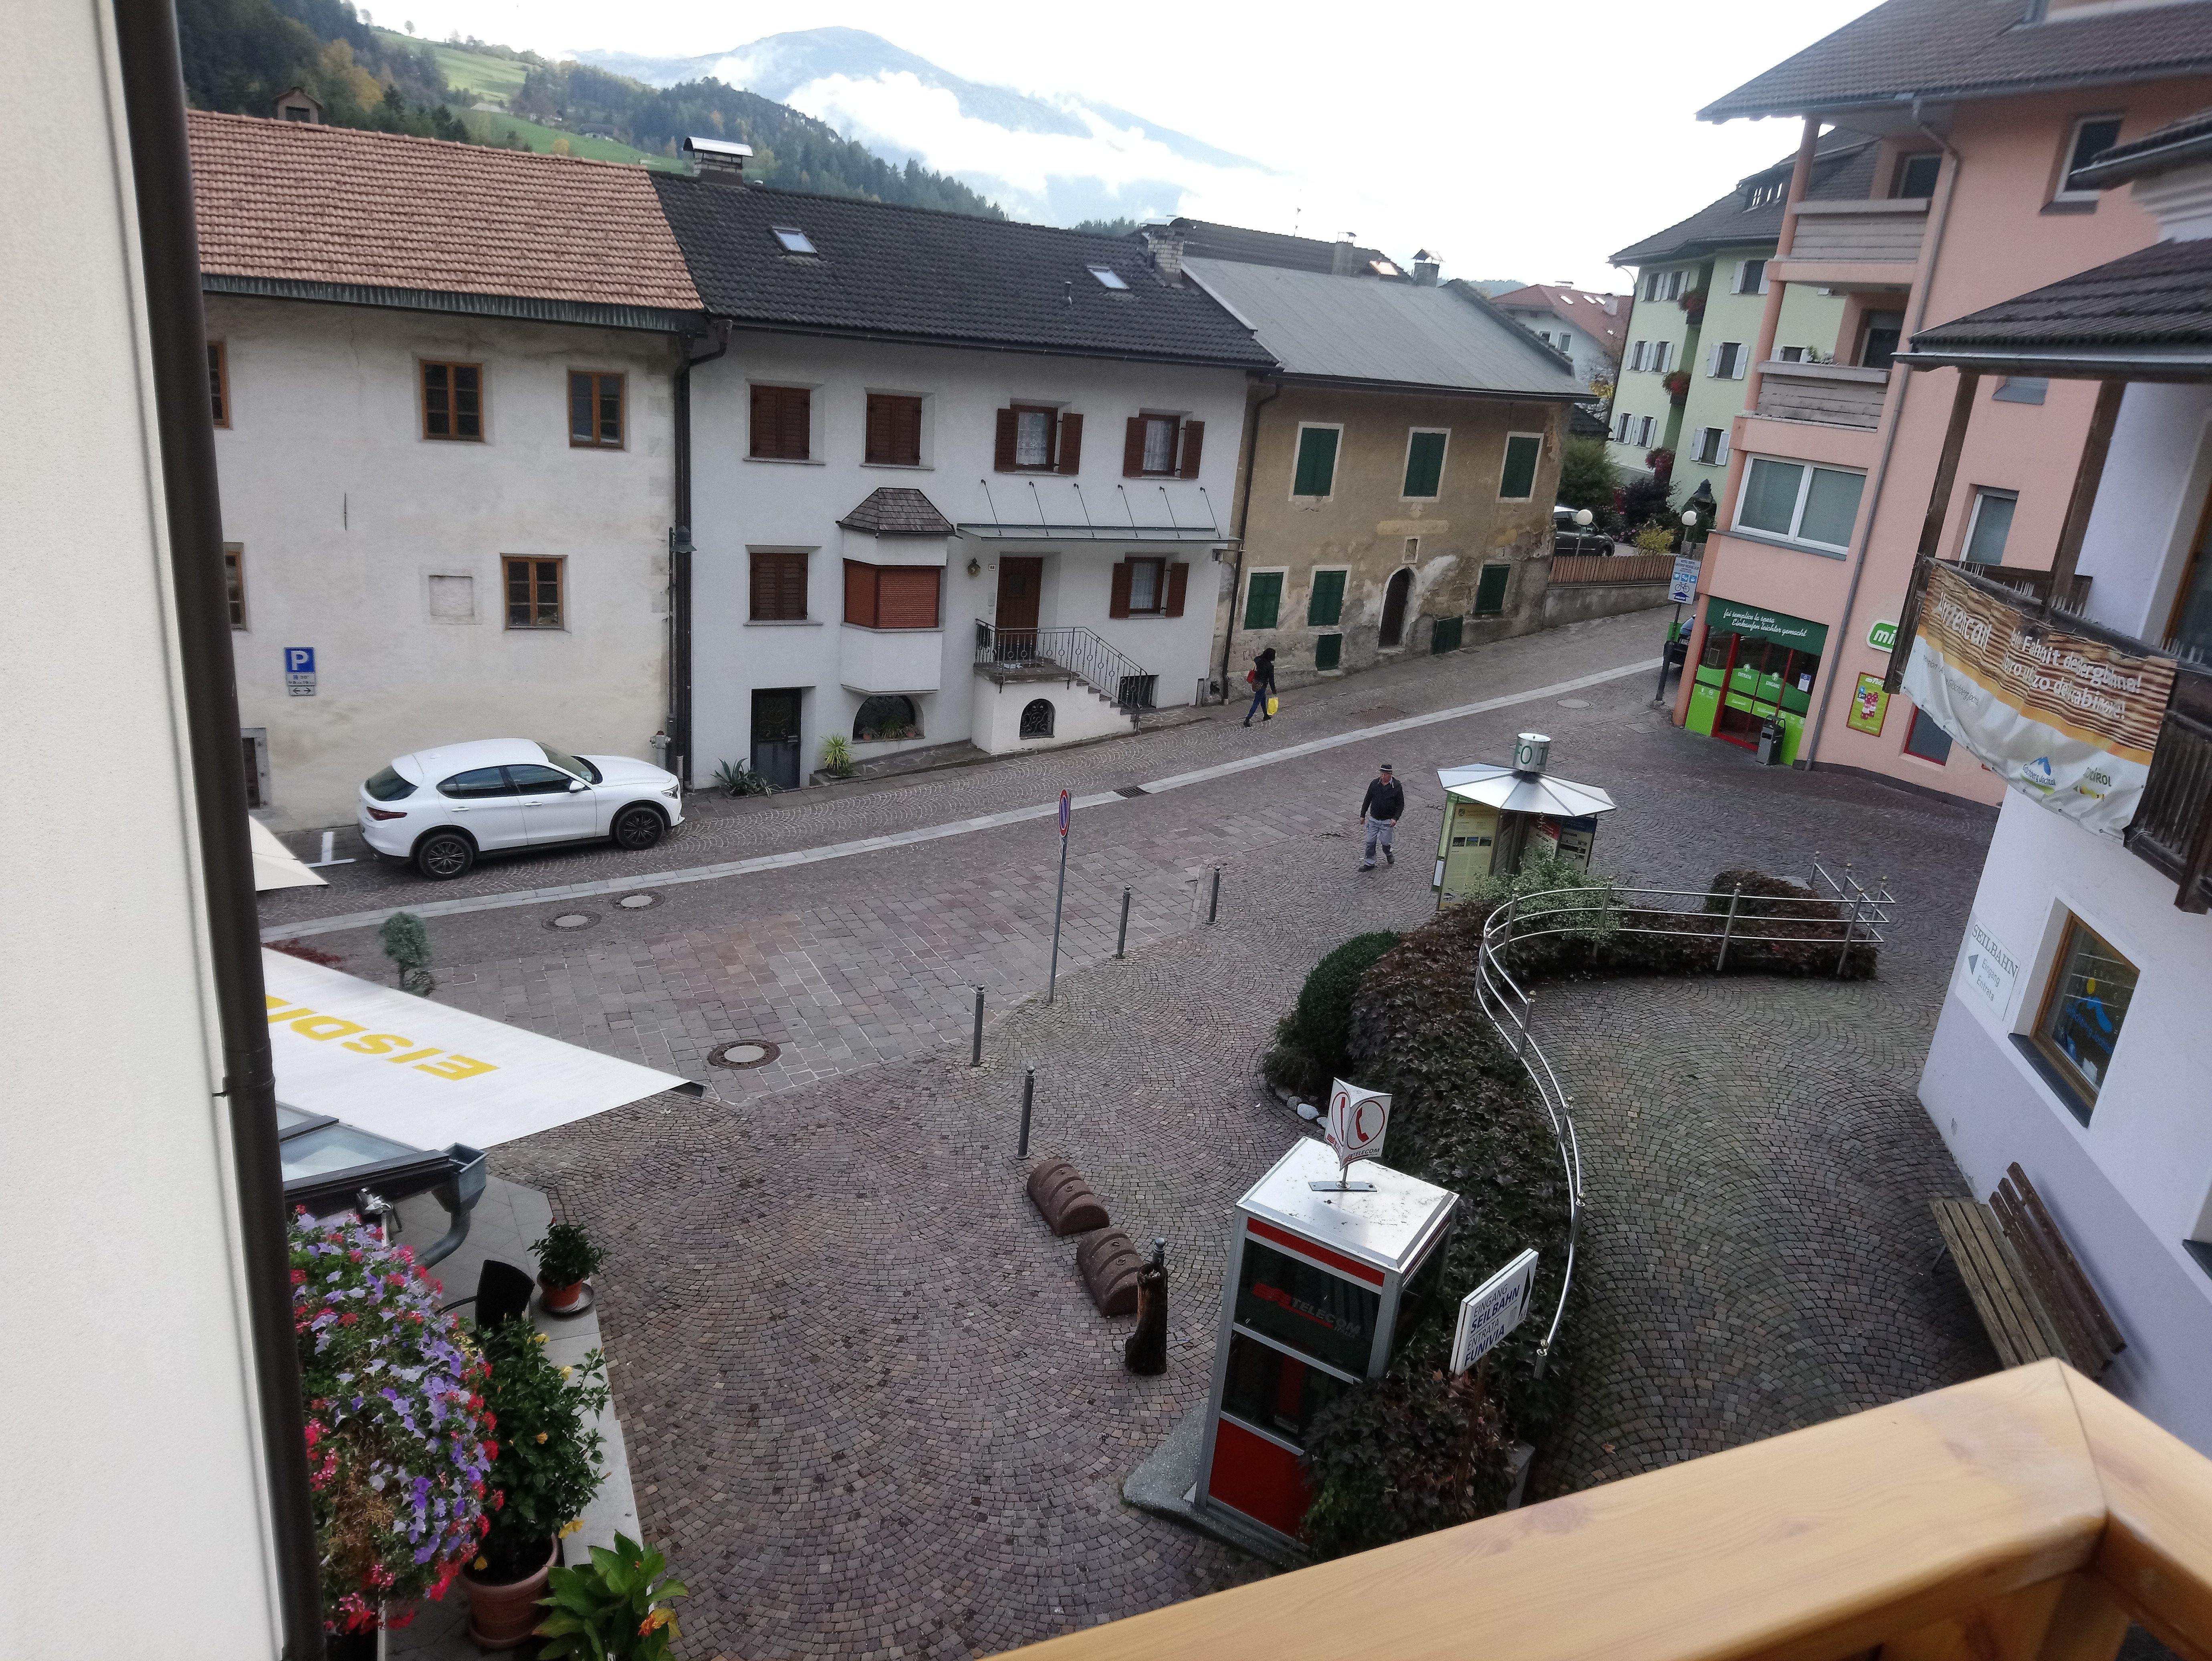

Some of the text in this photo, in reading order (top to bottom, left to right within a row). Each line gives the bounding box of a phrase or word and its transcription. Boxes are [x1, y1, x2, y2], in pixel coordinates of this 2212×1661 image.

[1731, 619, 1808, 637] Einkaufen leichter gemacht
[1873, 630, 1897, 645] mi
[291, 651, 308, 671] P
[1738, 672, 1752, 680] ENTRATA
[1972, 924, 2018, 978] SEILBAHN
[1982, 958, 2000, 988] Eingang
[1977, 975, 1994, 1002] Entrata
[1353, 1148, 1380, 1157] TELECOM
[1292, 1297, 1361, 1334] TELECOM
[1470, 1284, 1520, 1334] SEILBAHN
[1474, 1283, 1508, 1318] EINGANG
[1464, 1324, 1505, 1367] FUNIVIA
[1467, 1318, 1500, 1352] ENTRATA
